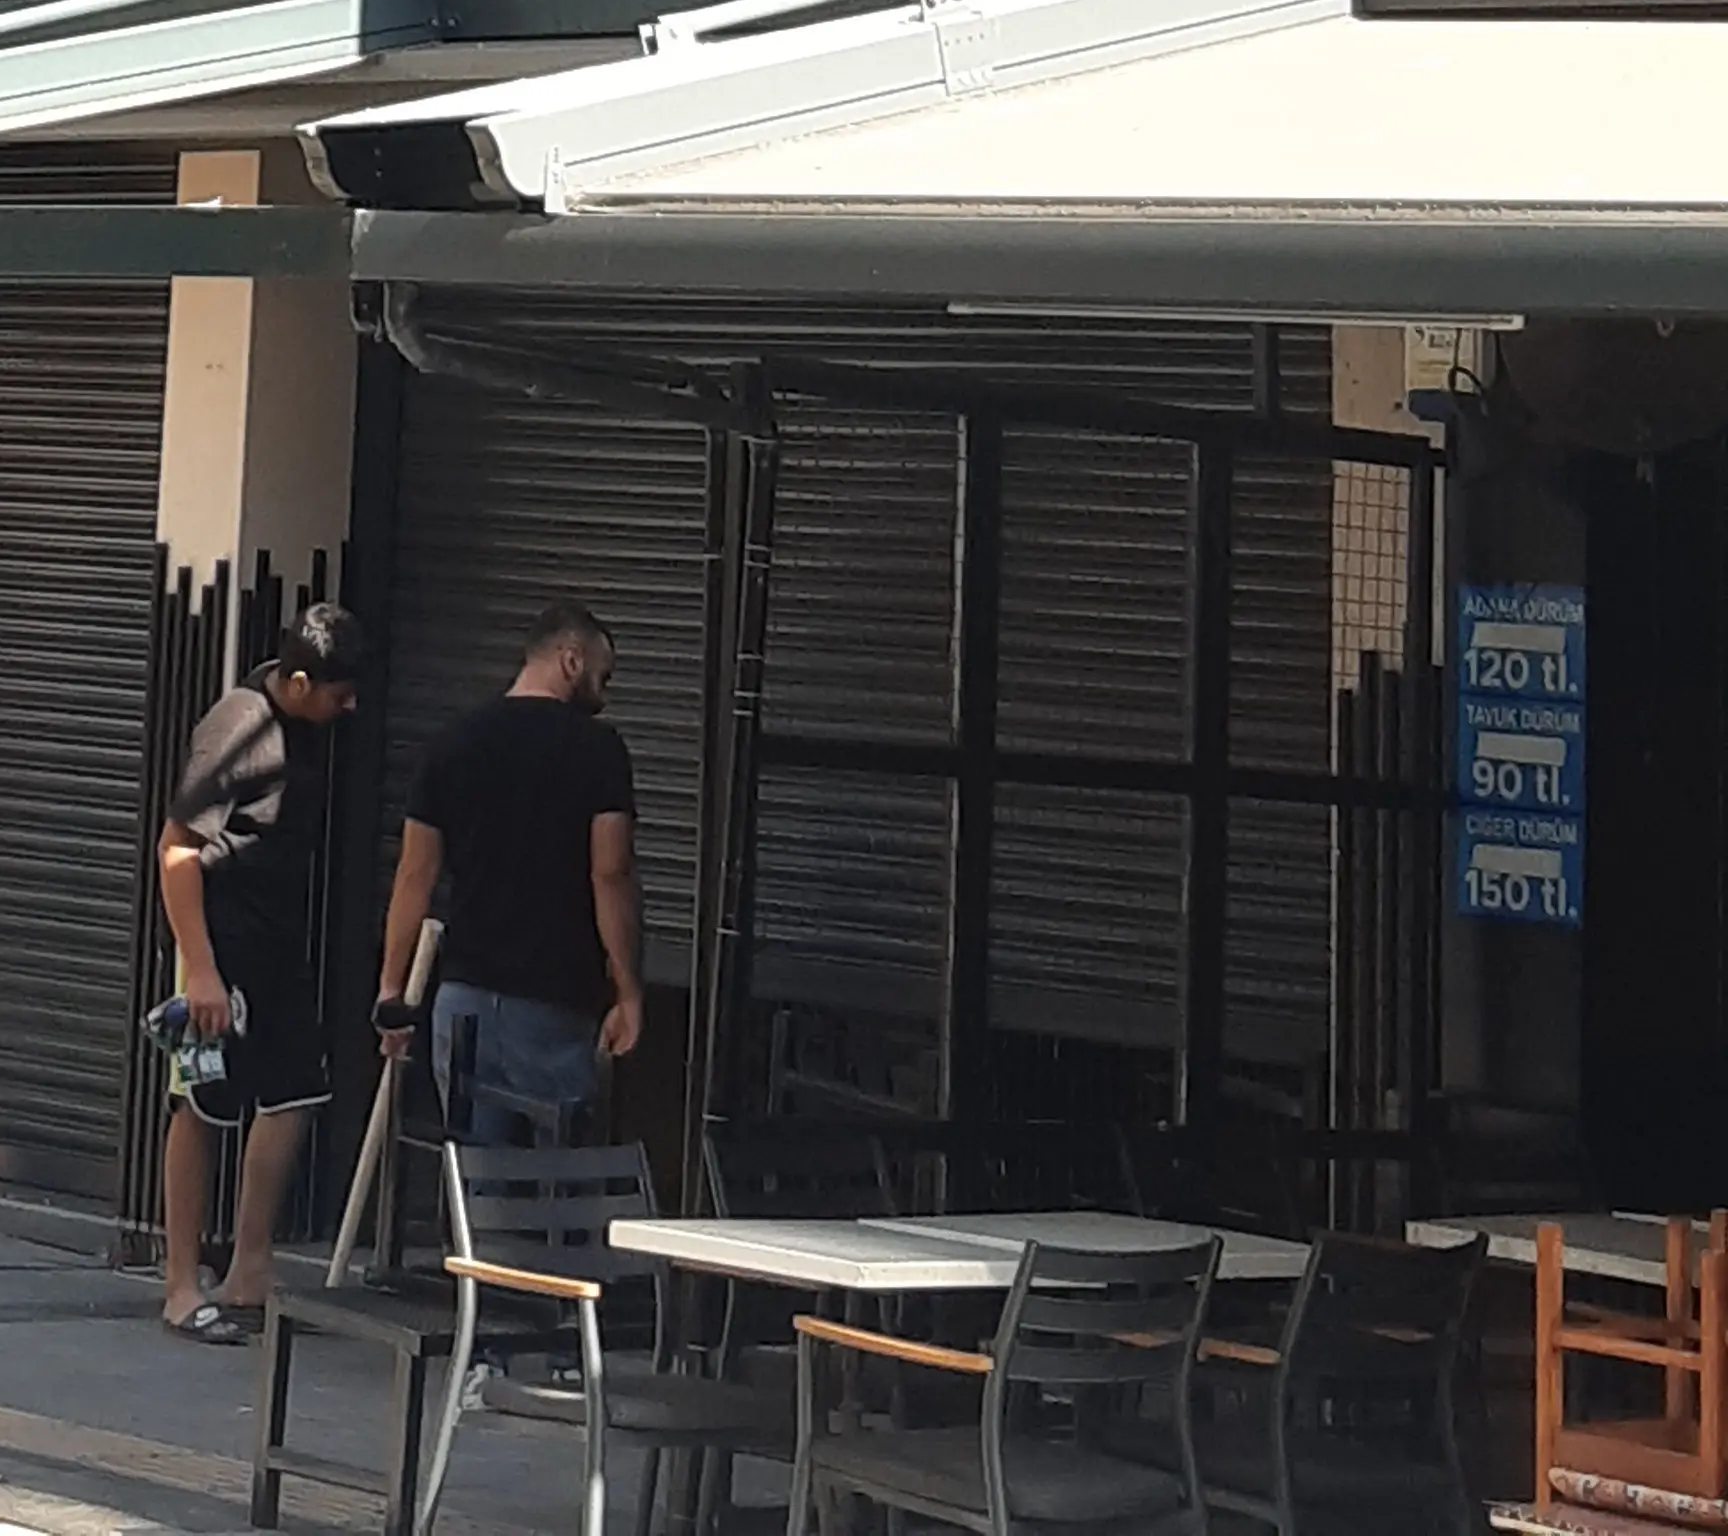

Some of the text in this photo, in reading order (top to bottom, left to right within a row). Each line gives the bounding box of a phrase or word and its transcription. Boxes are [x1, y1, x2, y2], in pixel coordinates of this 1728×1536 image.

[1464, 648, 1529, 689] 120
[1473, 760, 1523, 801] 90
[1464, 869, 1530, 912] 150
